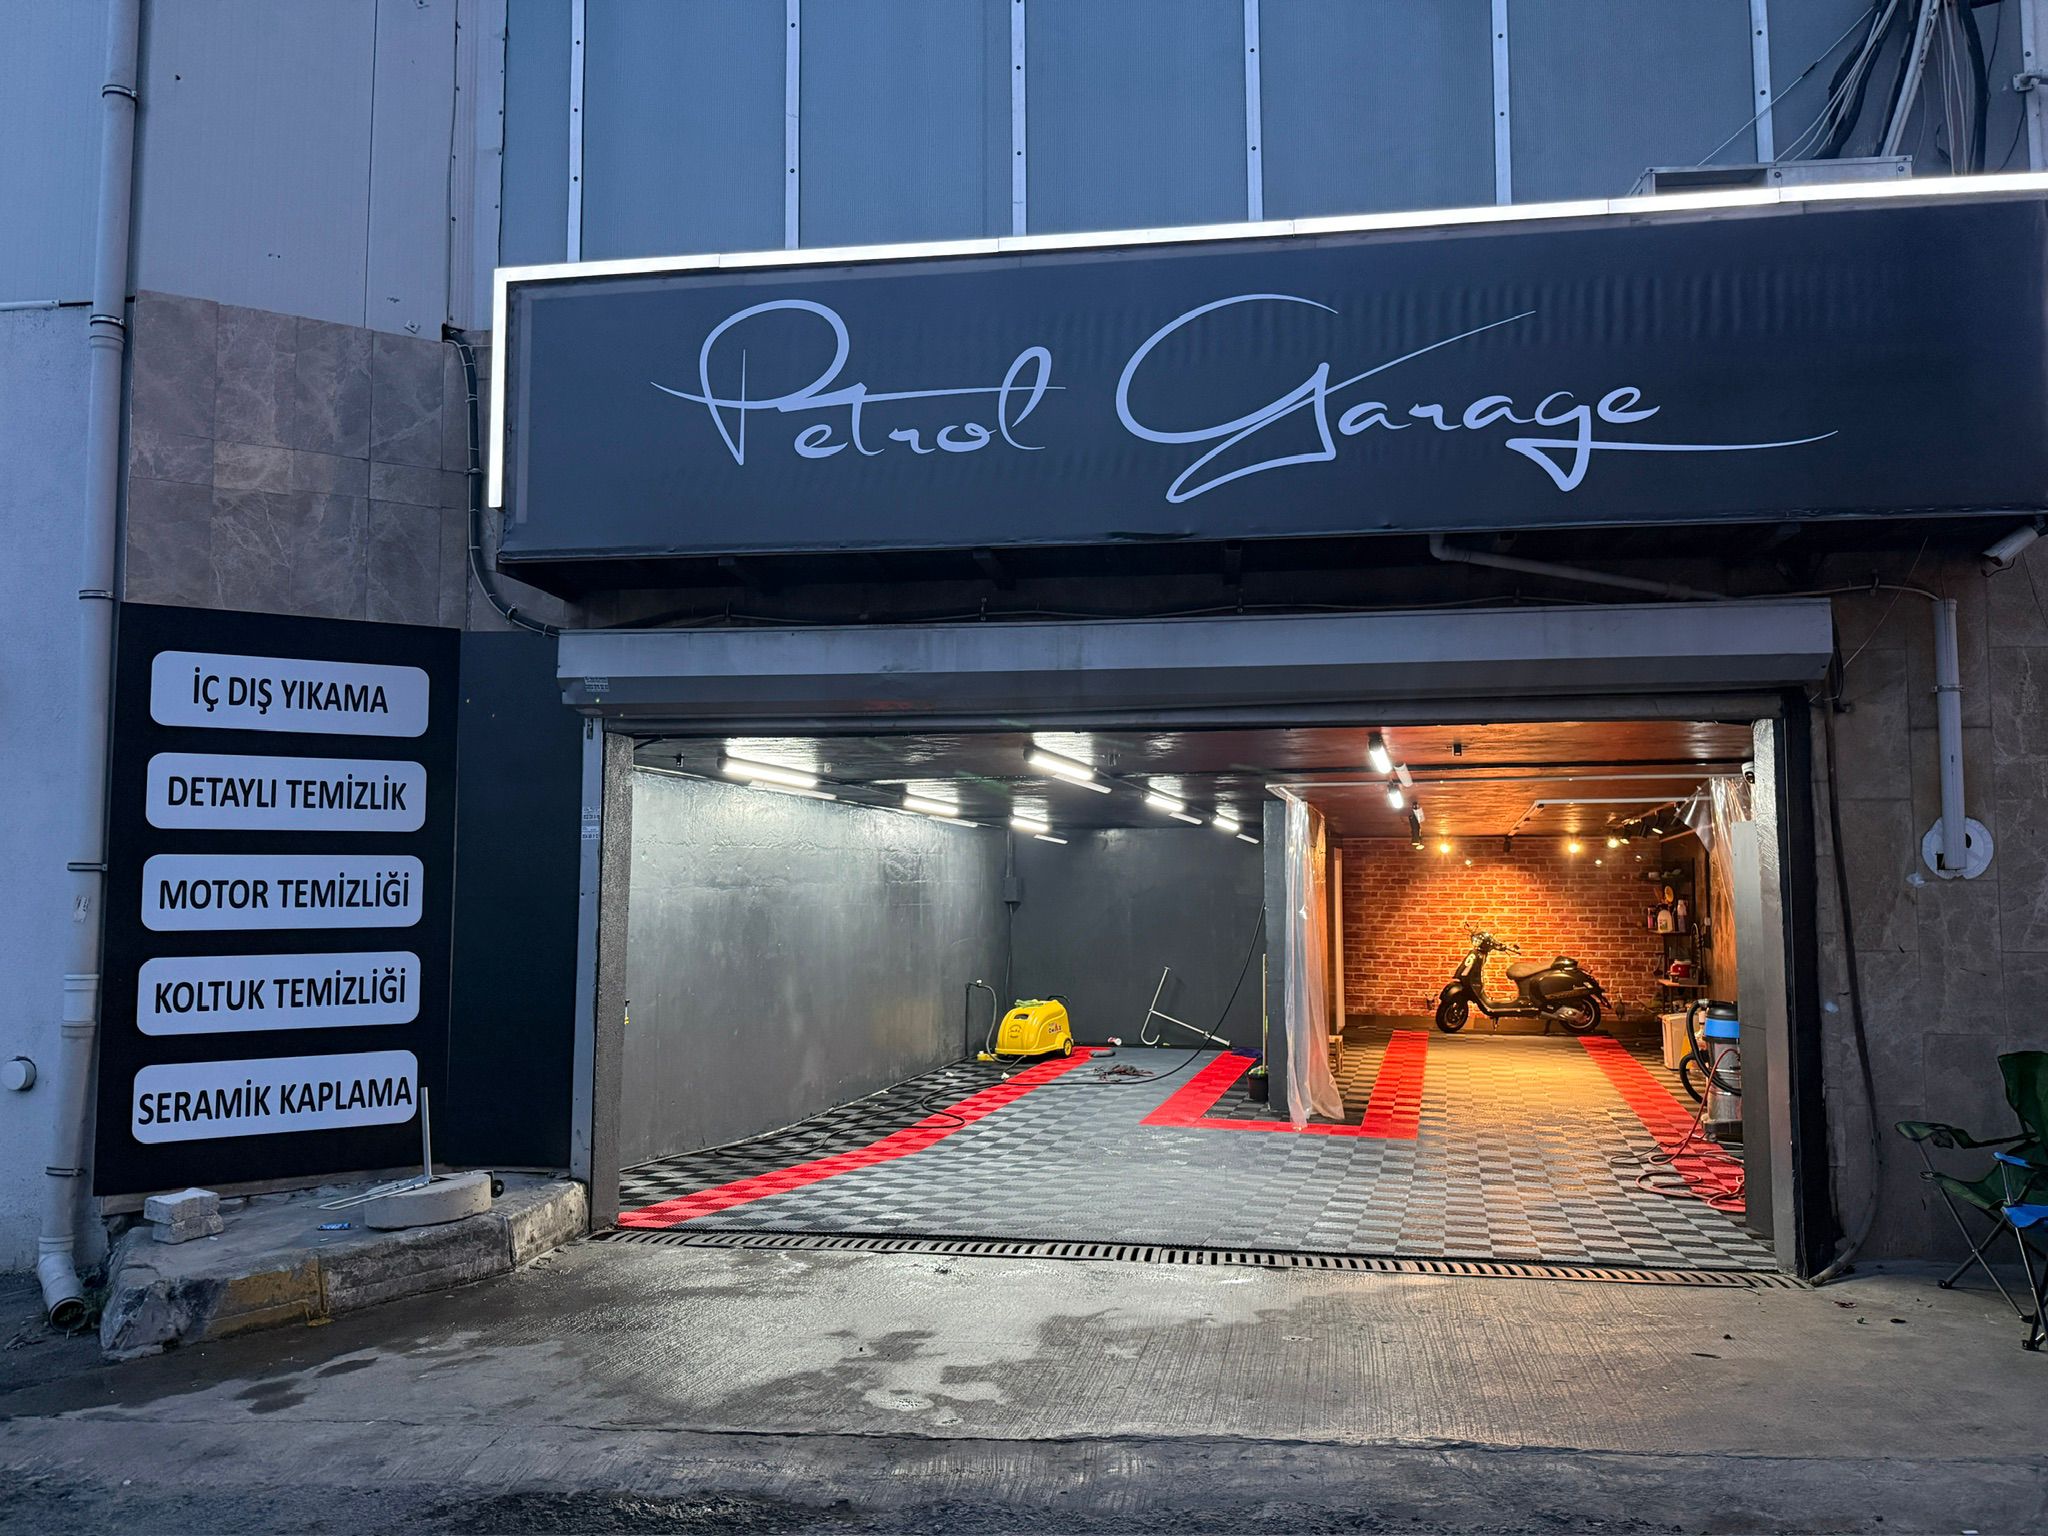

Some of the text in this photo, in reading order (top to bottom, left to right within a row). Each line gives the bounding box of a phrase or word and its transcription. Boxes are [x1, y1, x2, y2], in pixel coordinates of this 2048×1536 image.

[651, 293, 1838, 503] Petrol Garage
[193, 666, 389, 715] İÇ DIŞ YIKAMA
[167, 773, 407, 811] DETAYLI TEMİZLİK
[159, 871, 410, 910] MOTOR TEMİZLİĞİ
[154, 966, 406, 1014] KOLTUK TEMİZLİĞİ
[137, 1076, 413, 1126] SERAMİK KAPLAMA
